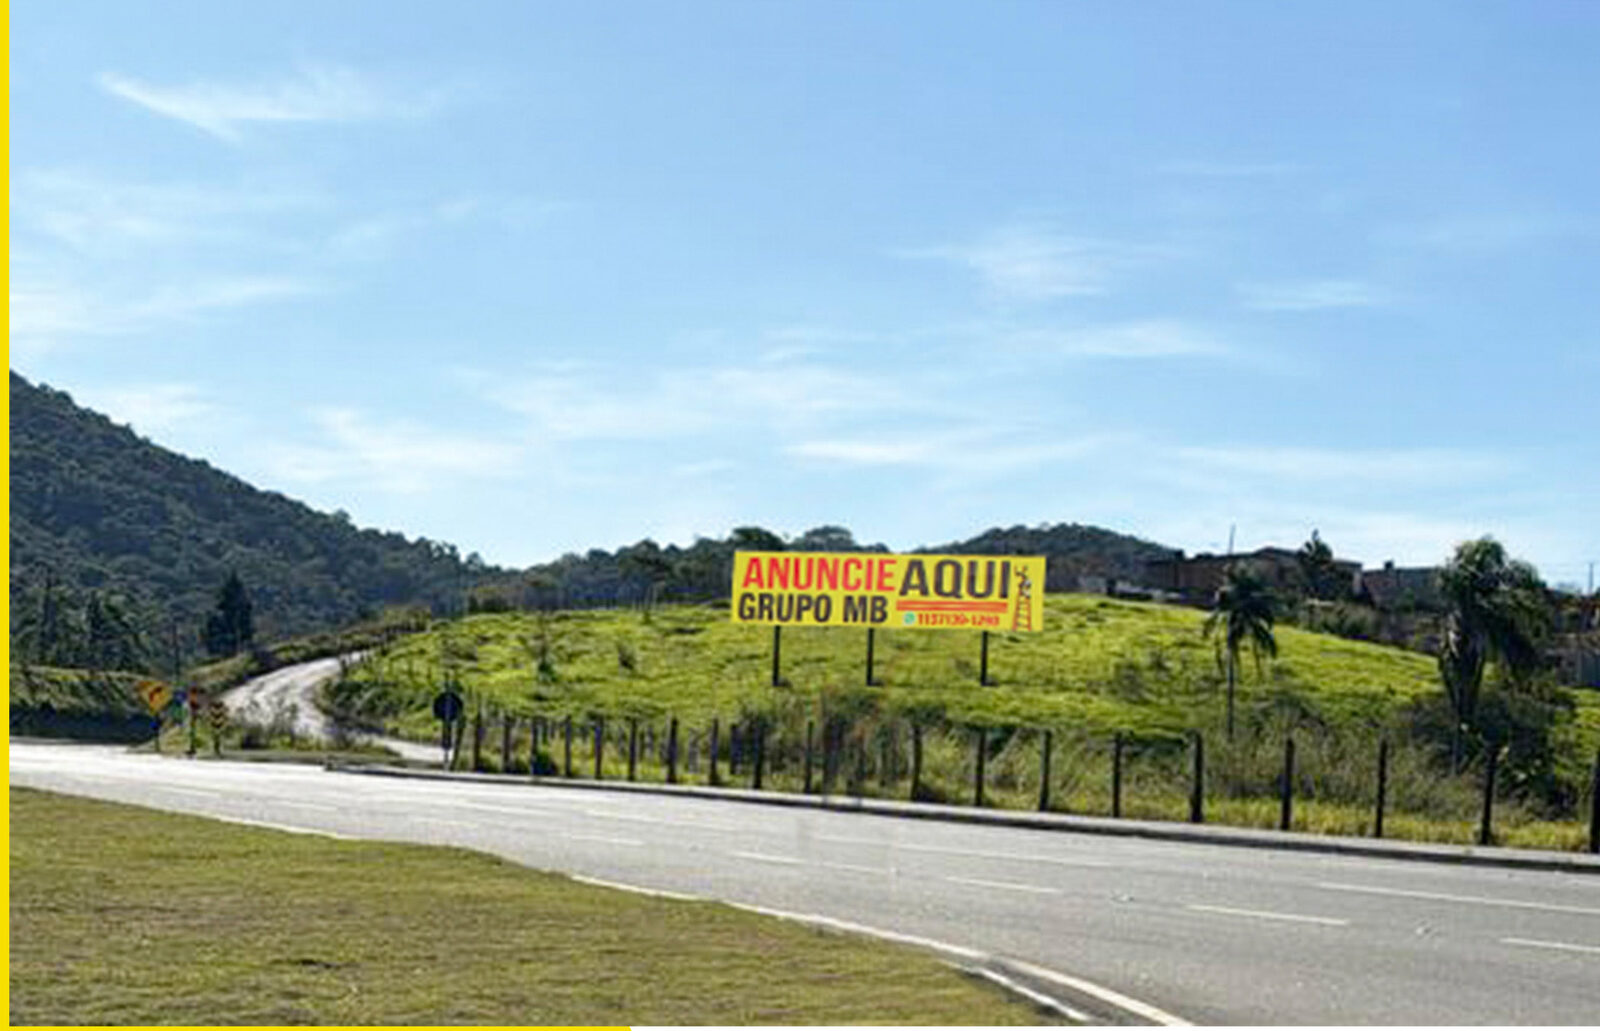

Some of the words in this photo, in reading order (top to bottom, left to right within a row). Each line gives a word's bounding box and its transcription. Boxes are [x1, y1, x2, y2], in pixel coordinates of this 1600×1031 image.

[742, 556, 897, 591] ANUNCIE
[899, 559, 1011, 599] AQUI
[738, 592, 832, 623] GRUPO
[842, 595, 889, 624] MB
